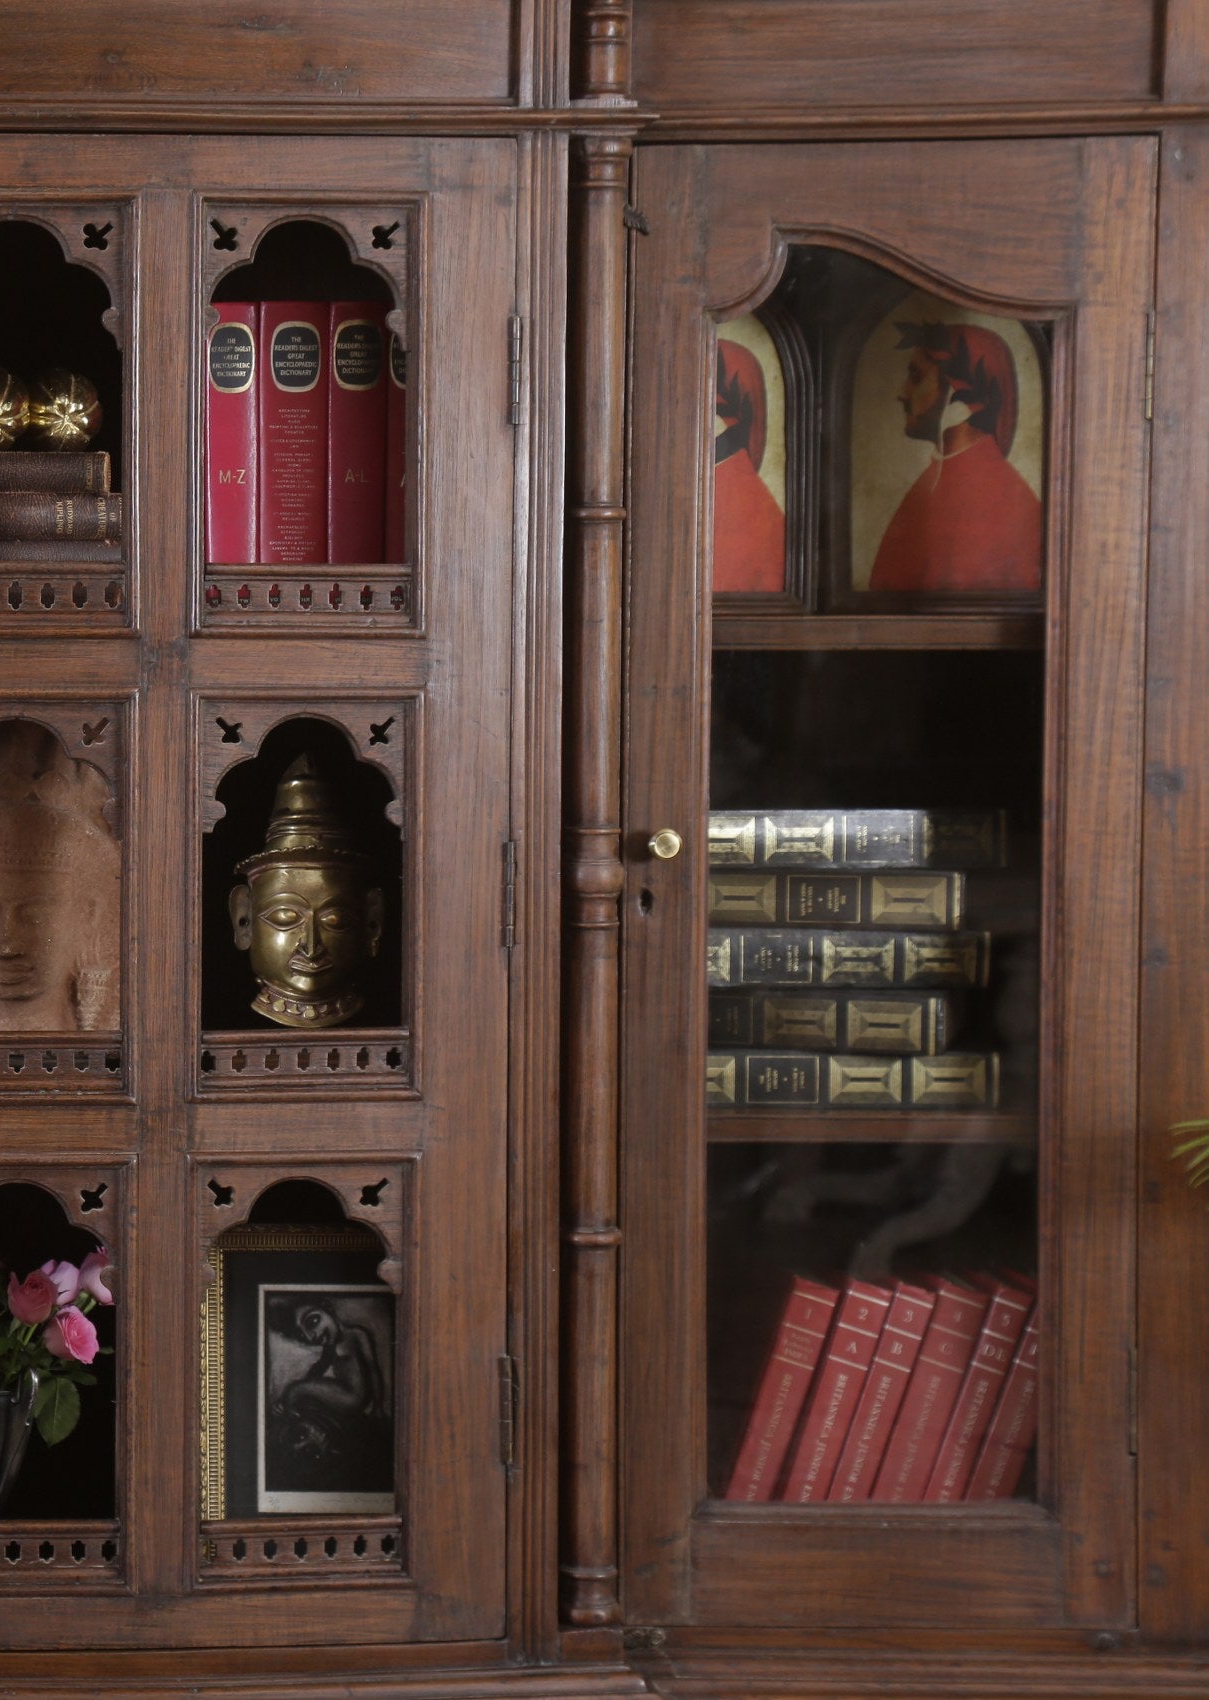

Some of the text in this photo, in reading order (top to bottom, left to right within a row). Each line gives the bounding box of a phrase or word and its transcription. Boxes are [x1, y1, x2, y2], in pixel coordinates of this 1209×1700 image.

[234, 345, 252, 353] DIGEST
[287, 352, 306, 361] GREAT
[279, 369, 313, 377] DICTIONARY
[218, 468, 246, 485] M-Z
[345, 468, 370, 484] A-L
[55, 501, 64, 534] KIPLING
[66, 499, 75, 535] RUDYARD
[857, 1308, 869, 1321] 2
[902, 1309, 914, 1324] 3
[1001, 1313, 1011, 1327] 5
[846, 1341, 858, 1354] A
[891, 1341, 904, 1356] B
[765, 1373, 793, 1438] BRITANNICA
[820, 1373, 850, 1439] BRITANNICA
[862, 1375, 893, 1440] BRITANNICA
[958, 1379, 990, 1445] BRITANNICA
[751, 1439, 772, 1481] JUNIOR
[805, 1439, 828, 1483] JUNIOR
[847, 1440, 870, 1484] JUNIOR
[942, 1444, 966, 1488] JUNIOR
